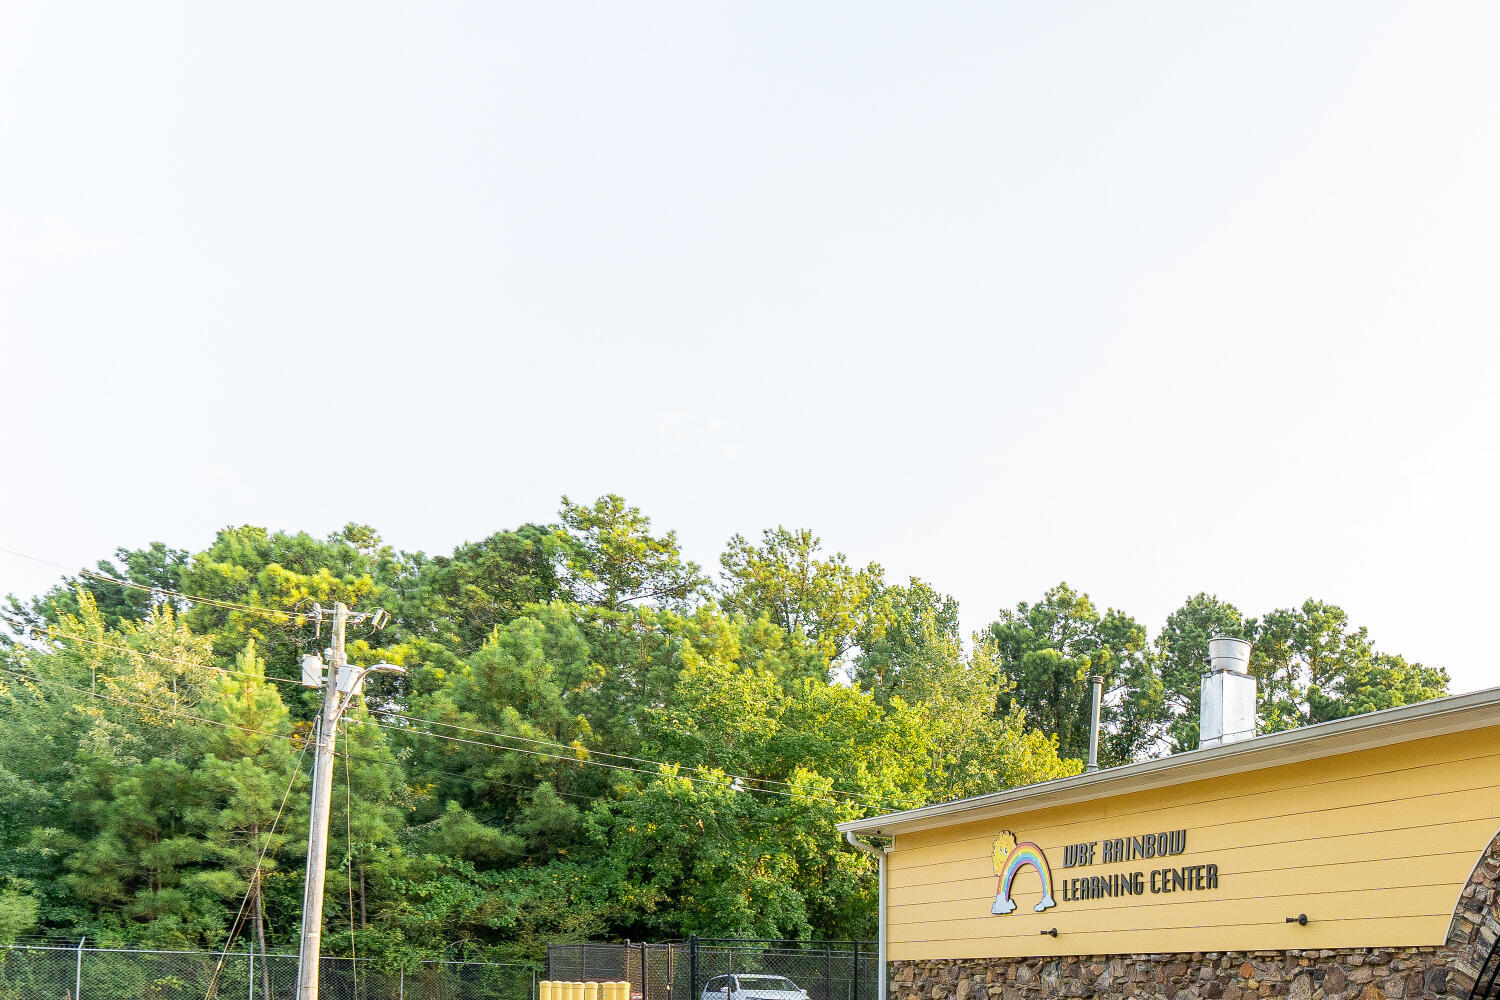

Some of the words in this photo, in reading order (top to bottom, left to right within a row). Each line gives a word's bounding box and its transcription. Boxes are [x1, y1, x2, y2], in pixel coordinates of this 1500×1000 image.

[1063, 842, 1097, 868] WBF
[1102, 829, 1187, 864] RAINBOW
[1062, 872, 1144, 902] LEARNING
[1150, 863, 1219, 894] CENTER
